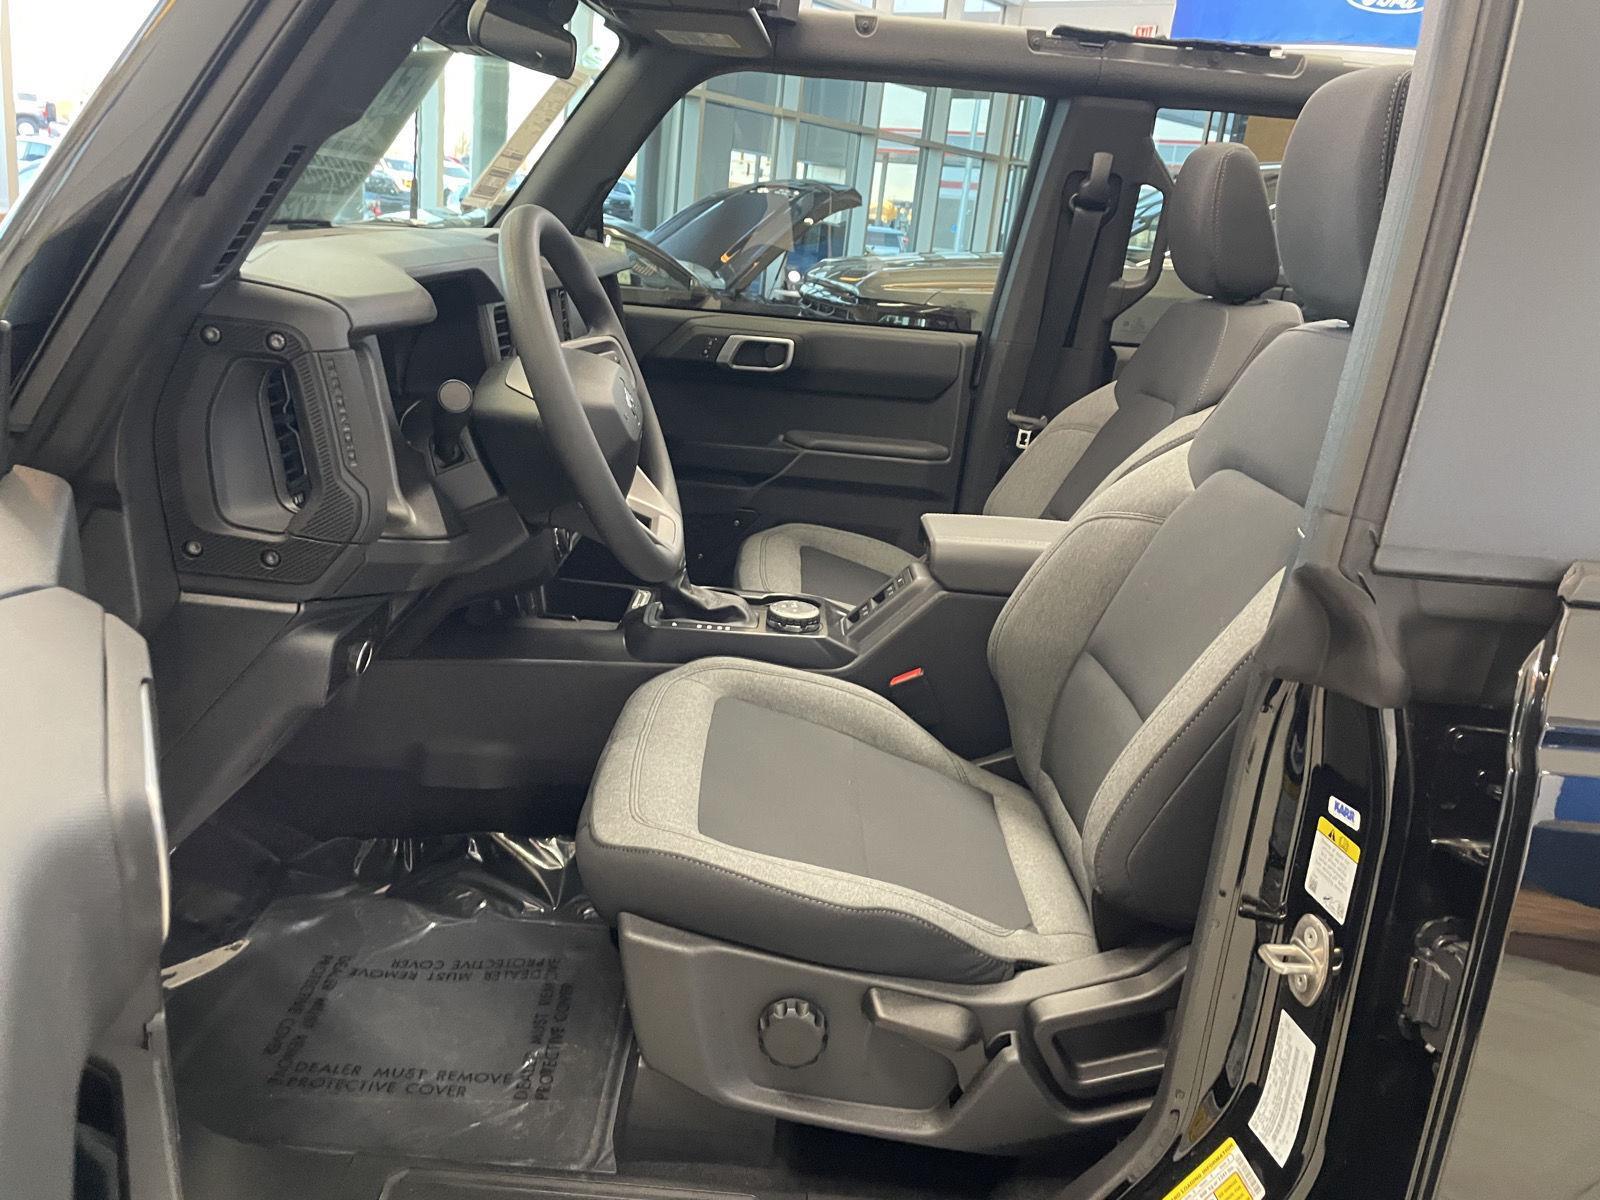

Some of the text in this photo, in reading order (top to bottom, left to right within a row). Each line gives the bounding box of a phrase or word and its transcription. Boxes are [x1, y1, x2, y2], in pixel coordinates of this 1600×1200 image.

[294, 1060, 517, 1086] DEALER MUST REMOVE
[286, 1076, 467, 1098] PROTECTIVE COVER
